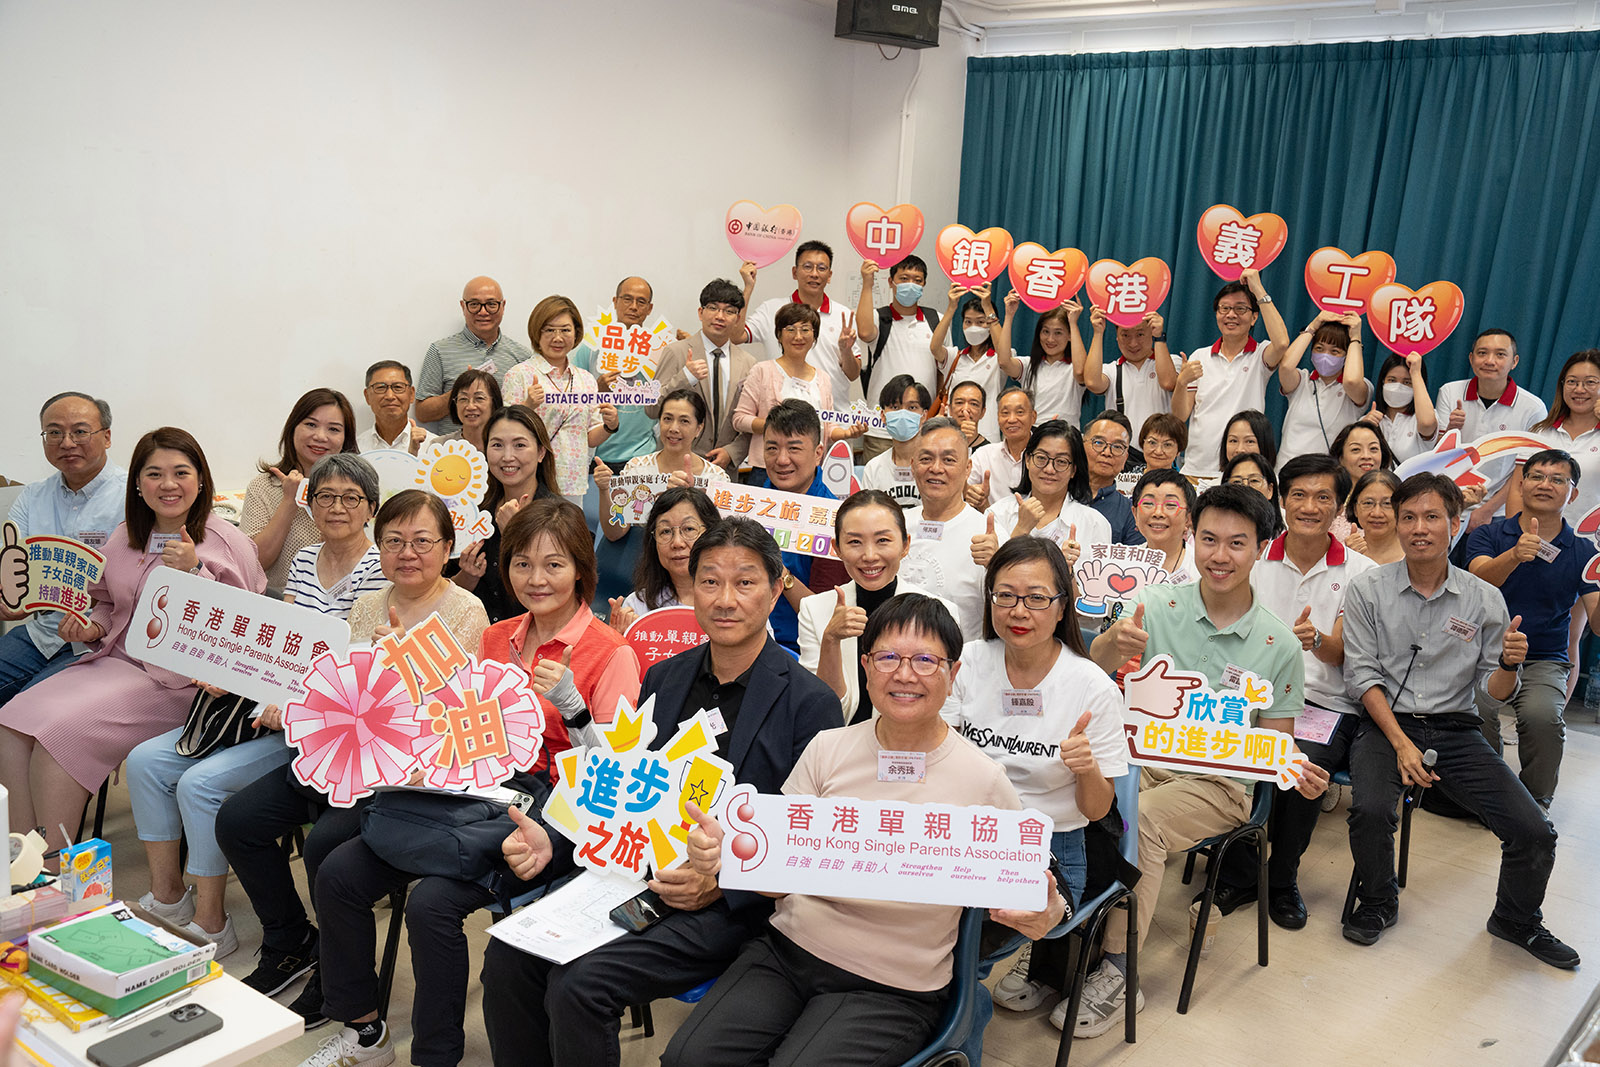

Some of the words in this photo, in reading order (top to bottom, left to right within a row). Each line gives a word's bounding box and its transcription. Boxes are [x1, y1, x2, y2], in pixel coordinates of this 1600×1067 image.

[866, 216, 903, 256] 中
[1212, 219, 1262, 269] 義
[950, 237, 992, 279] 銀
[1025, 257, 1066, 300] 香
[1105, 272, 1147, 315] 港
[1320, 262, 1370, 308] 工
[1387, 296, 1436, 344] 隊
[602, 325, 652, 357] 品格
[600, 352, 640, 374] 進步
[545, 393, 579, 404] ESTATE
[581, 393, 594, 404] OF
[597, 393, 611, 404] NG
[613, 393, 632, 404] YUK
[634, 393, 644, 404] OI
[821, 411, 834, 421] OF
[835, 413, 849, 424] NG
[852, 414, 870, 427] YUK
[714, 489, 802, 521] 進步之旅
[29, 544, 99, 582] 推動單親家庭
[1090, 543, 1164, 568] 家庭和睦
[42, 565, 86, 592] 子女品德
[38, 584, 88, 612] 持續進步
[177, 622, 196, 640] Hong
[197, 629, 218, 648] Kong
[219, 637, 242, 656] Single
[243, 644, 274, 664] Parents
[182, 599, 330, 662] 香港單親協會
[171, 641, 187, 654] 自強
[188, 647, 206, 660] 自助
[206, 652, 229, 669] 再助人
[263, 669, 276, 678] Help
[381, 613, 513, 771] 加油
[1186, 692, 1249, 728] 欣賞
[1143, 720, 1288, 767] 的進步啊!
[576, 754, 670, 819] 進步
[888, 765, 916, 776] 余秀珠
[786, 803, 1046, 847] 香港單親協會
[578, 820, 651, 874] 之旅
[786, 833, 822, 851] Hong
[825, 836, 860, 854] Kong
[864, 838, 906, 857] Single
[909, 841, 962, 858] Parents
[963, 845, 1042, 863] Association
[785, 855, 814, 869] 自強
[817, 858, 846, 871] 自助
[851, 860, 890, 874] 再助人
[897, 869, 935, 878] ourselves
[900, 861, 943, 871] Strengthen
[949, 873, 987, 882] ourselves
[953, 865, 972, 874] Help
[1000, 868, 1020, 877] Then
[996, 875, 1014, 885] help
[1015, 877, 1041, 887] others
[124, 980, 148, 994] NAME
[149, 971, 170, 985] CARD
[172, 958, 202, 973] HOLDER
